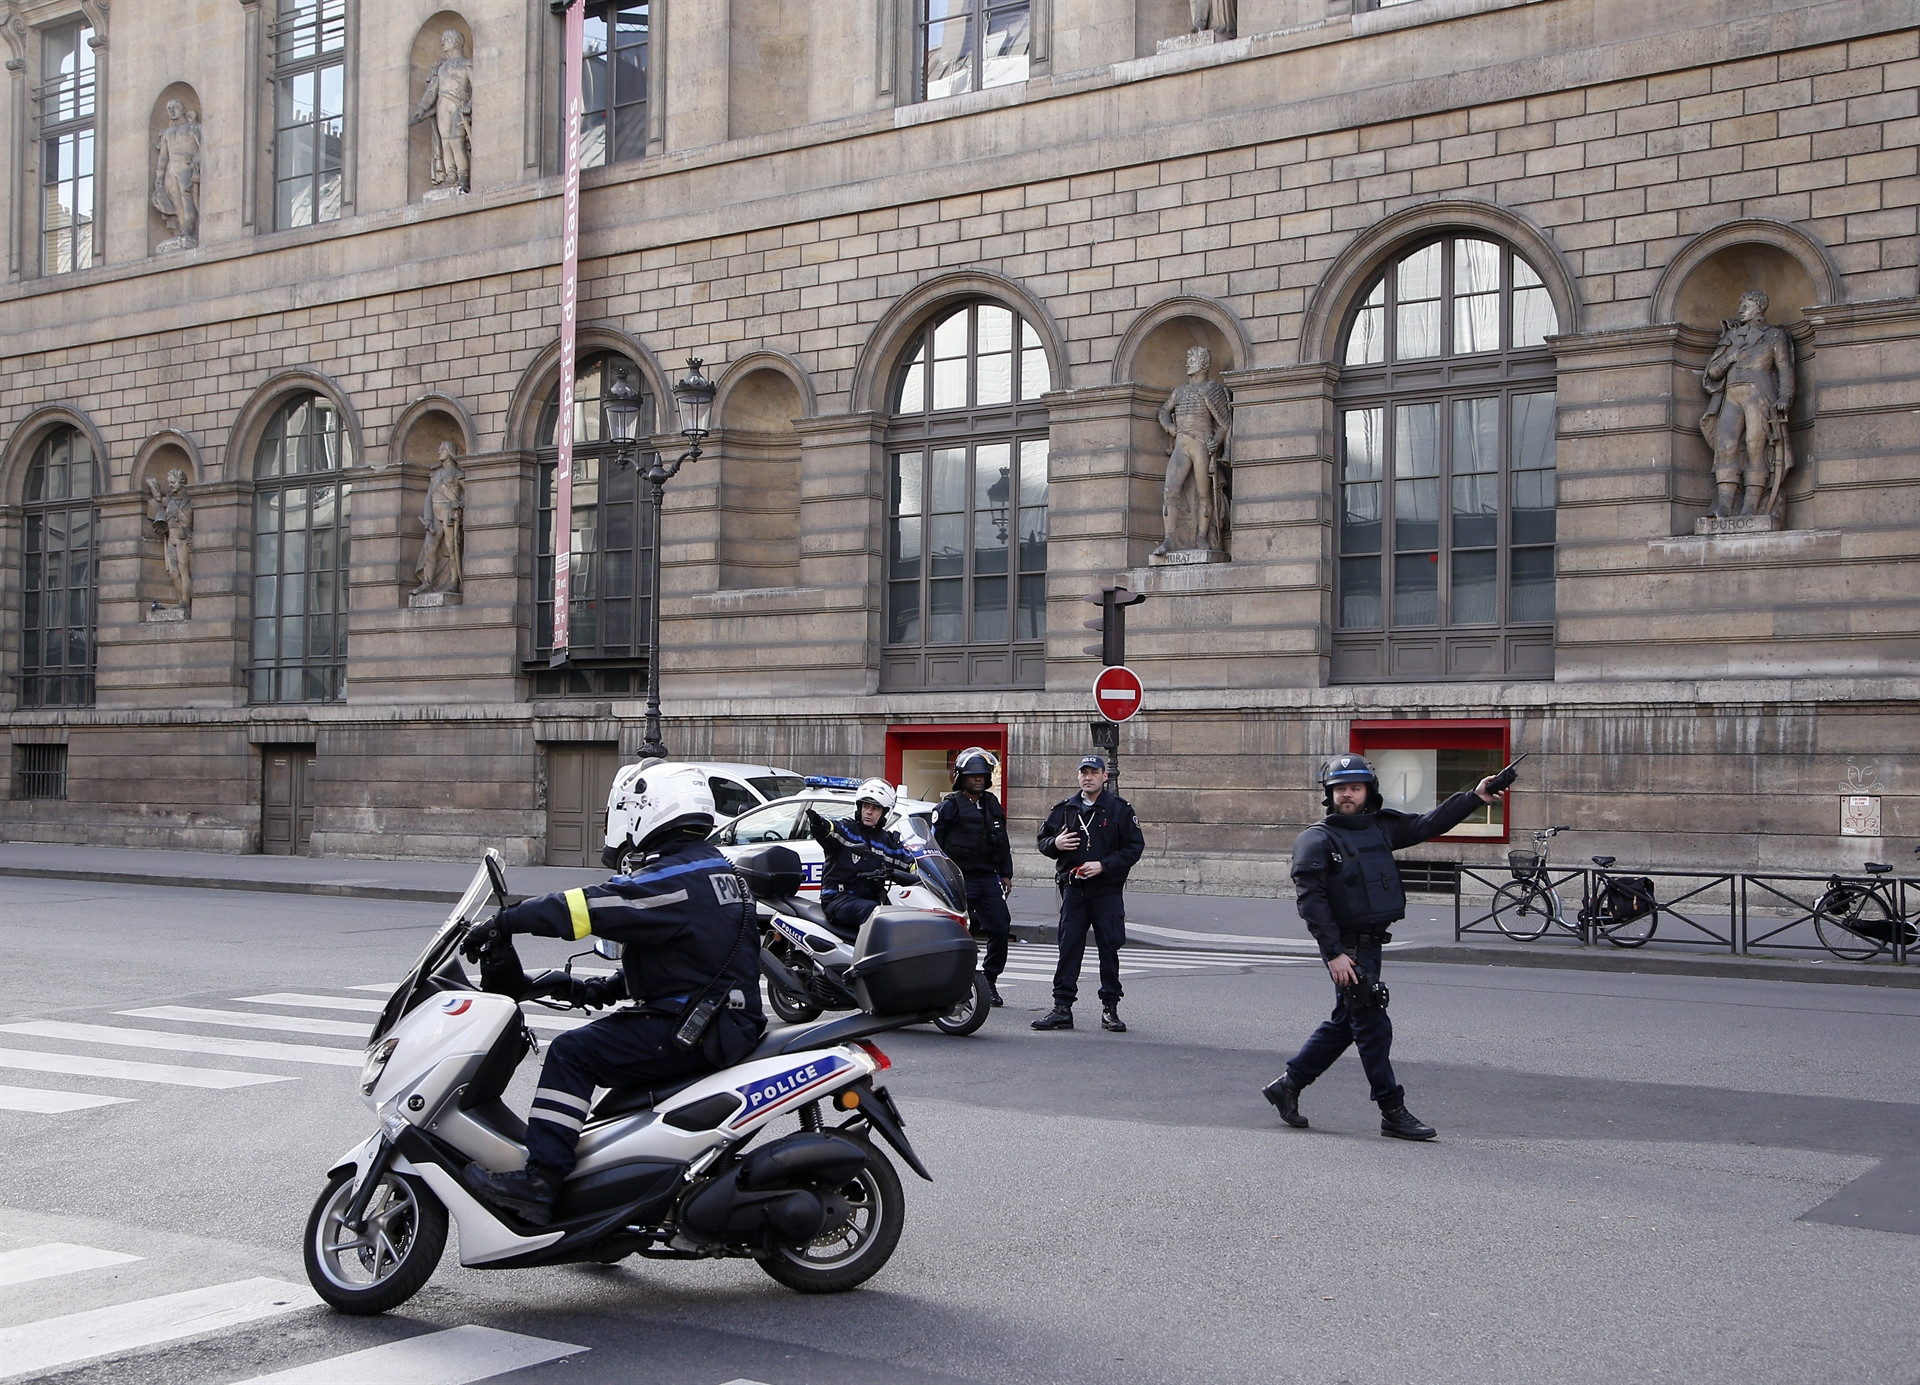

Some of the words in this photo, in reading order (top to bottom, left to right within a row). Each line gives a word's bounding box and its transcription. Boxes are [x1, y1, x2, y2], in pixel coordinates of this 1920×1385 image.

[565, 96, 578, 261] Bauhaus
[564, 275, 573, 322] du
[560, 336, 573, 480] L'esprit
[1711, 518, 1754, 530] DUROC
[1163, 553, 1191, 563] MURAT
[781, 922, 803, 942] POLICE
[749, 1064, 819, 1107] POLICE
